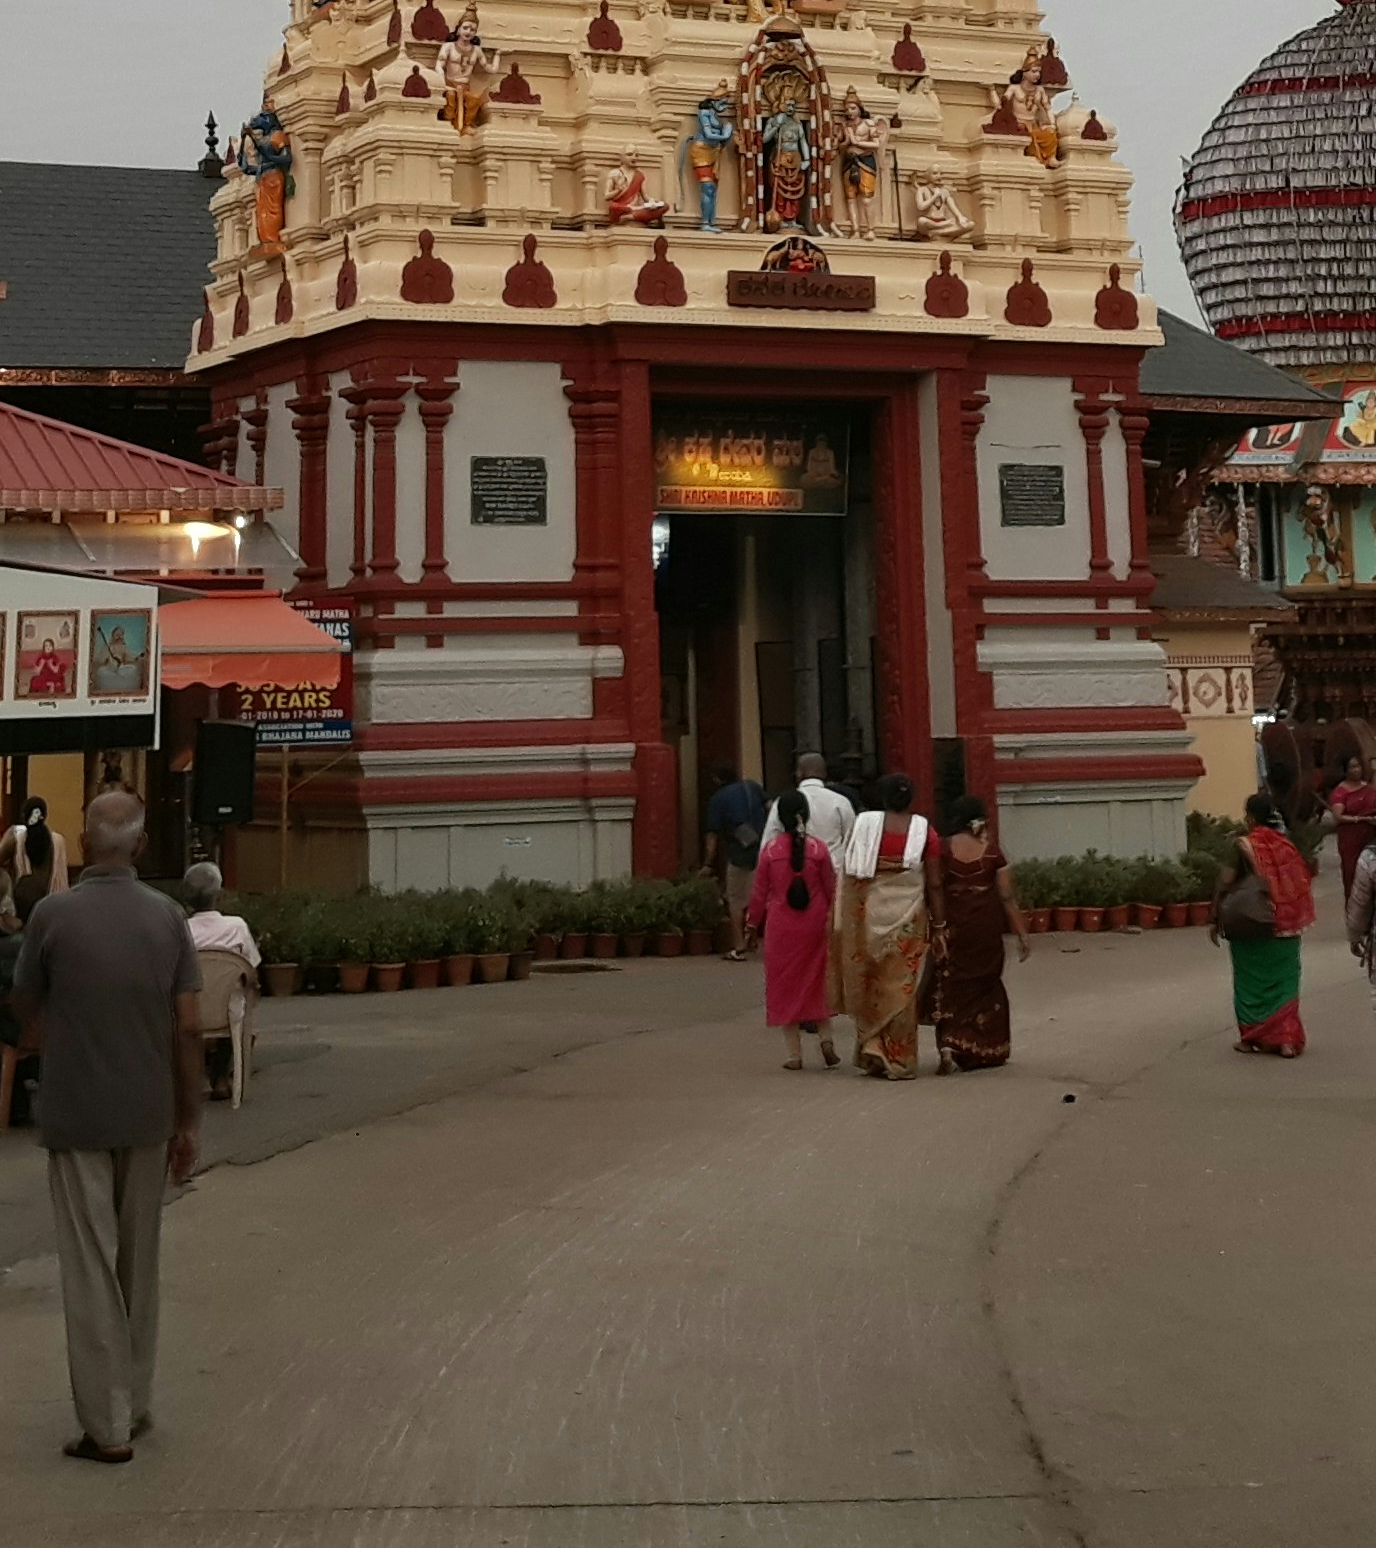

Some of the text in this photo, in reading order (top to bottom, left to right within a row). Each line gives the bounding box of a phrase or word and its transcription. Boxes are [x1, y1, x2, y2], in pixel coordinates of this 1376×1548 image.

[322, 608, 350, 619] MATHA
[315, 622, 351, 637] ANAS
[240, 691, 332, 710] 2 YEARS
[281, 711, 290, 719] to
[262, 731, 304, 741] BHAJANA
[305, 729, 351, 740] MANDALIS
